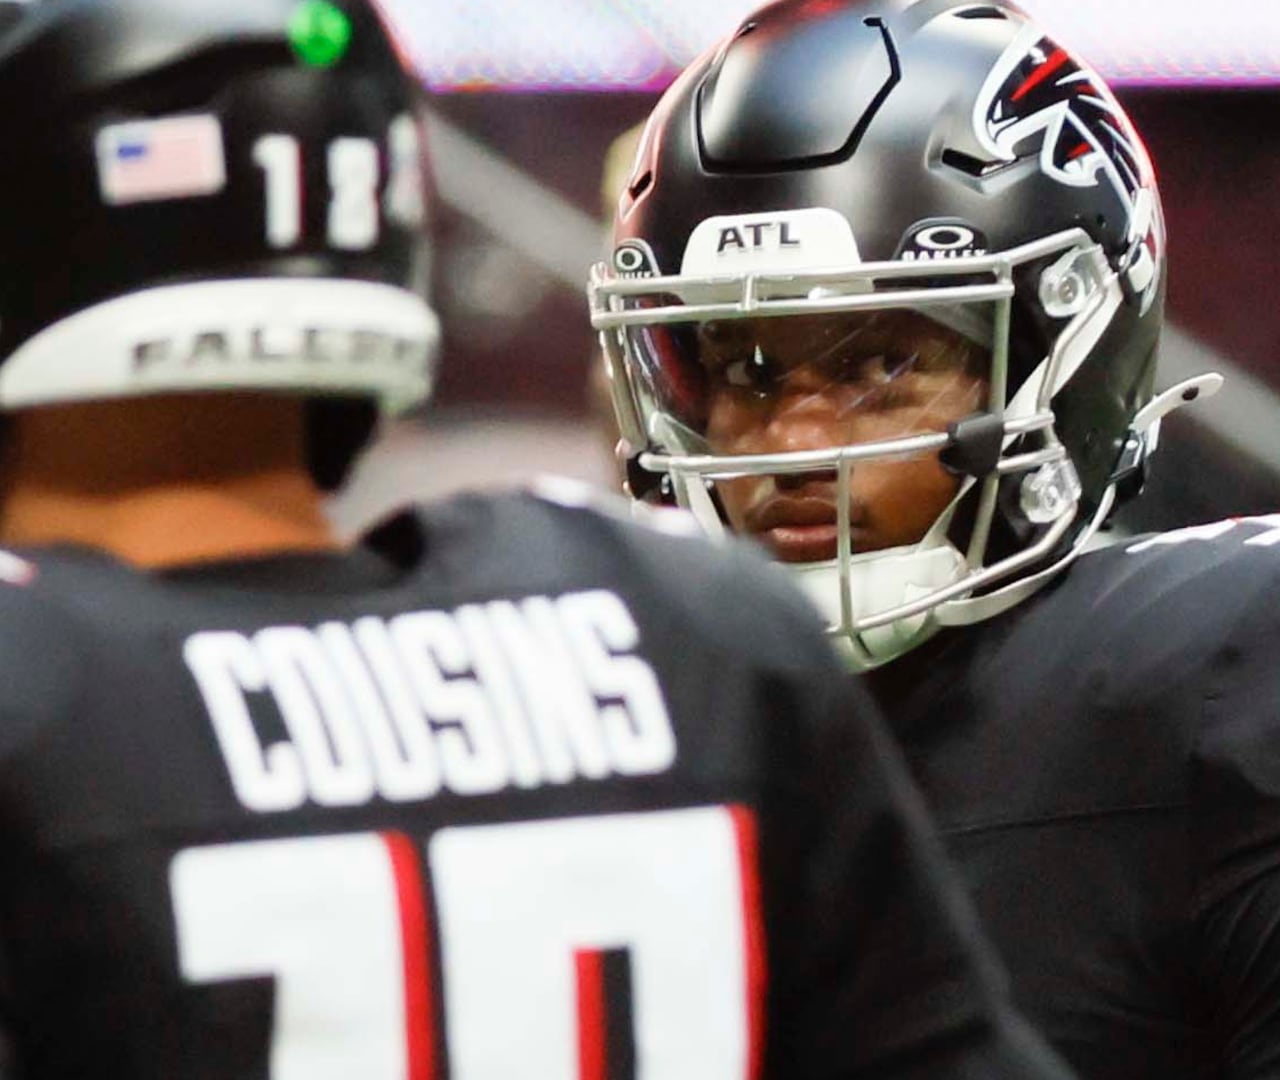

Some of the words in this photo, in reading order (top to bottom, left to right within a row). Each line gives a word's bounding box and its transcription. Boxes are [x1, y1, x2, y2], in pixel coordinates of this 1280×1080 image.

[252, 132, 380, 249] 18
[716, 221, 800, 252] ATL
[184, 590, 677, 811] COUSINS
